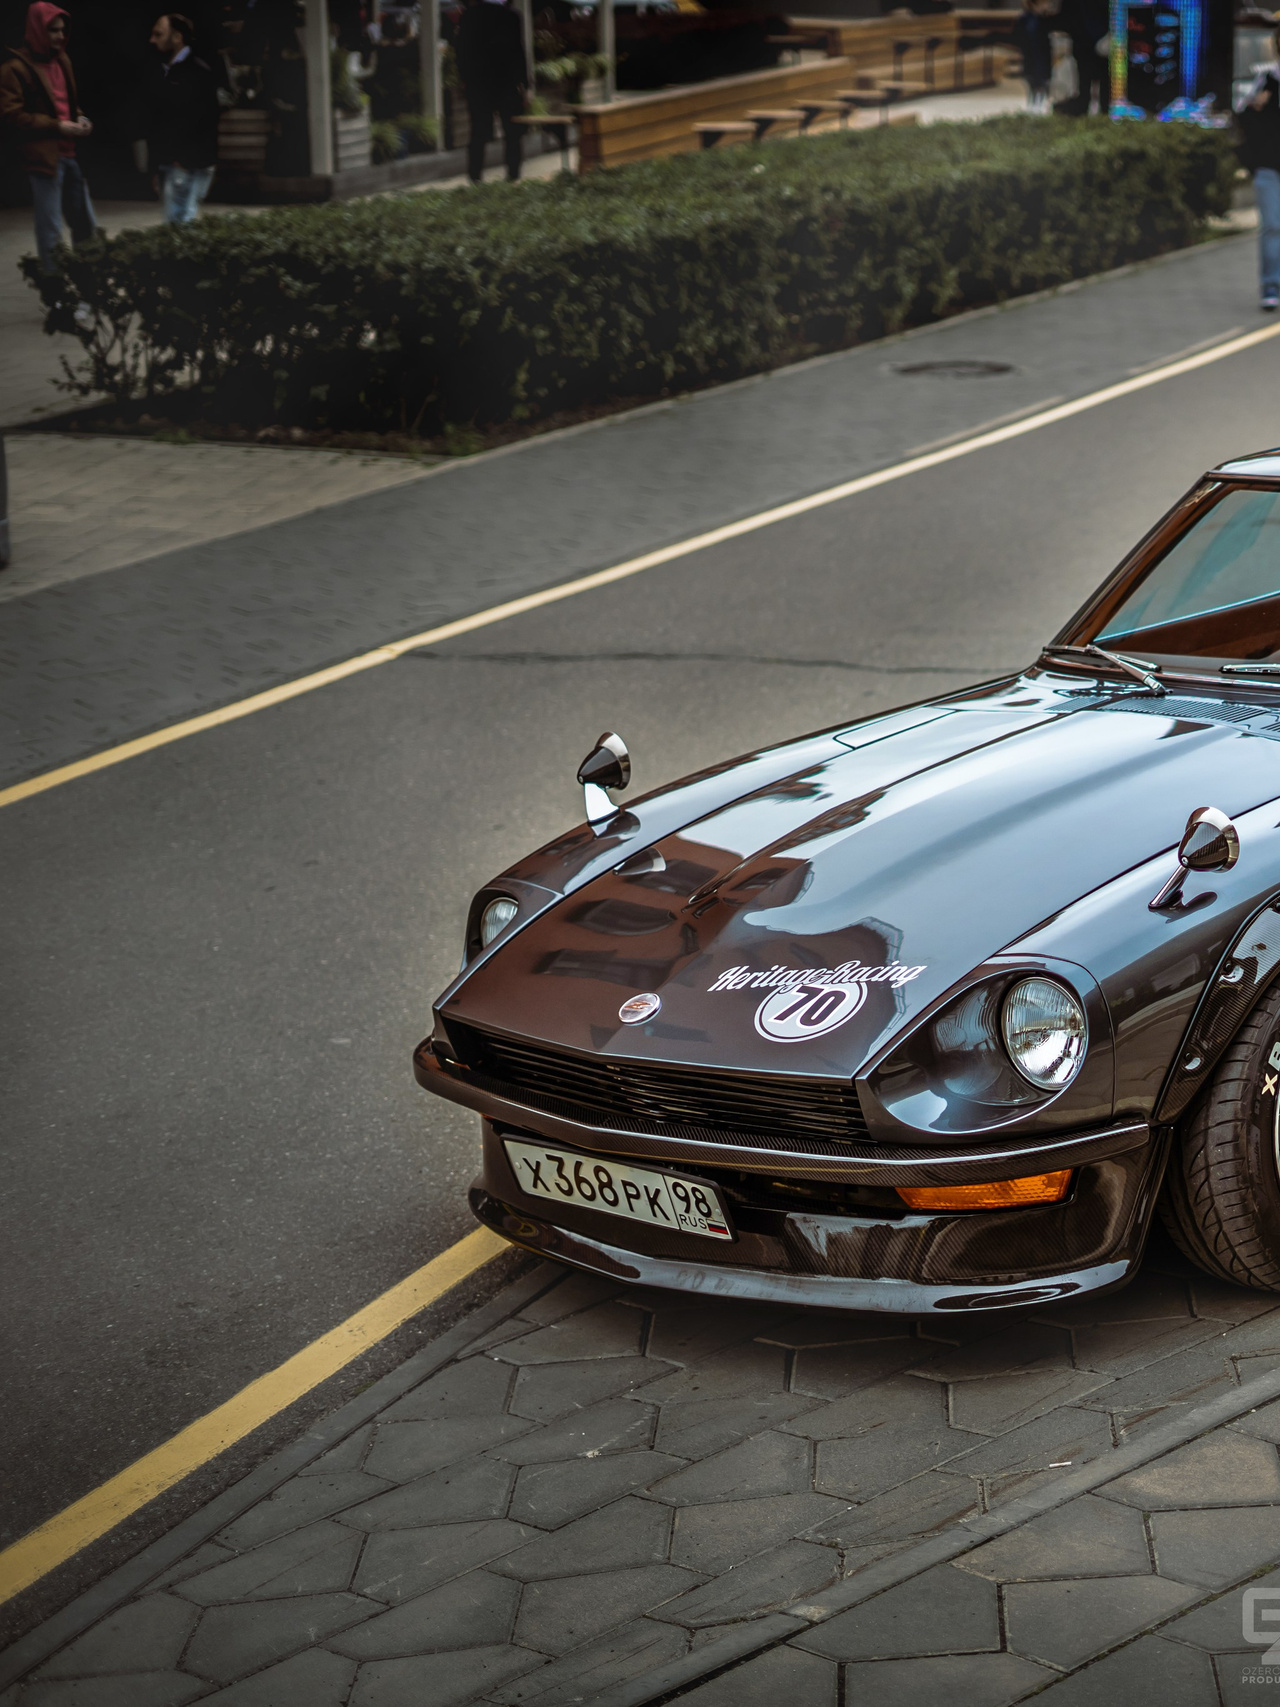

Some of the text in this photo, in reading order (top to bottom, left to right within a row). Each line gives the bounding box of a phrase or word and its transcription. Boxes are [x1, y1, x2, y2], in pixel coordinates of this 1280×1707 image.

[768, 984, 850, 1028] 70
[1261, 1073, 1278, 1095] X
[672, 1181, 712, 1218] 98
[679, 1214, 707, 1229] RUS
